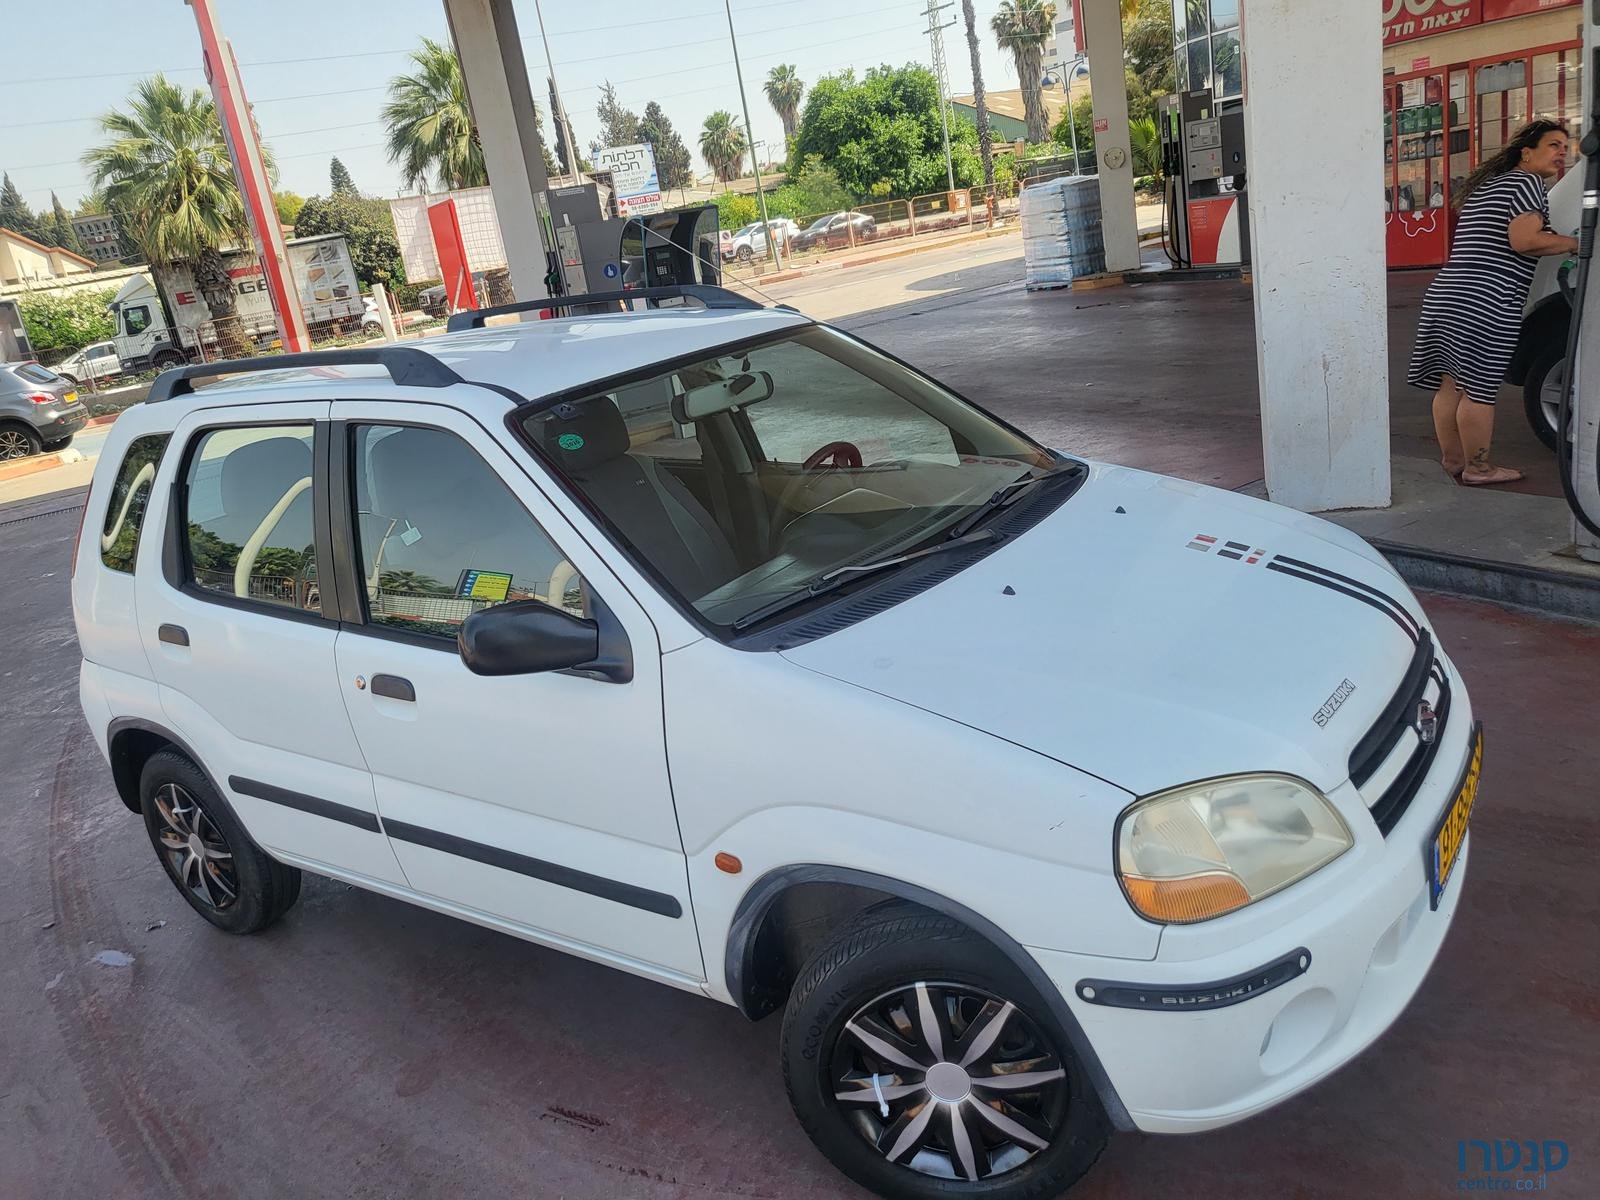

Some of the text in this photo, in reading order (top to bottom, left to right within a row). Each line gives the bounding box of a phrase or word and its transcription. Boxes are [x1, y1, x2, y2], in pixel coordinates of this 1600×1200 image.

[1421, 8, 1470, 31] יצאת
[602, 149, 644, 164] דלתות
[1313, 678, 1356, 727] SUZUKI
[1161, 984, 1253, 1005] SUZUKI
